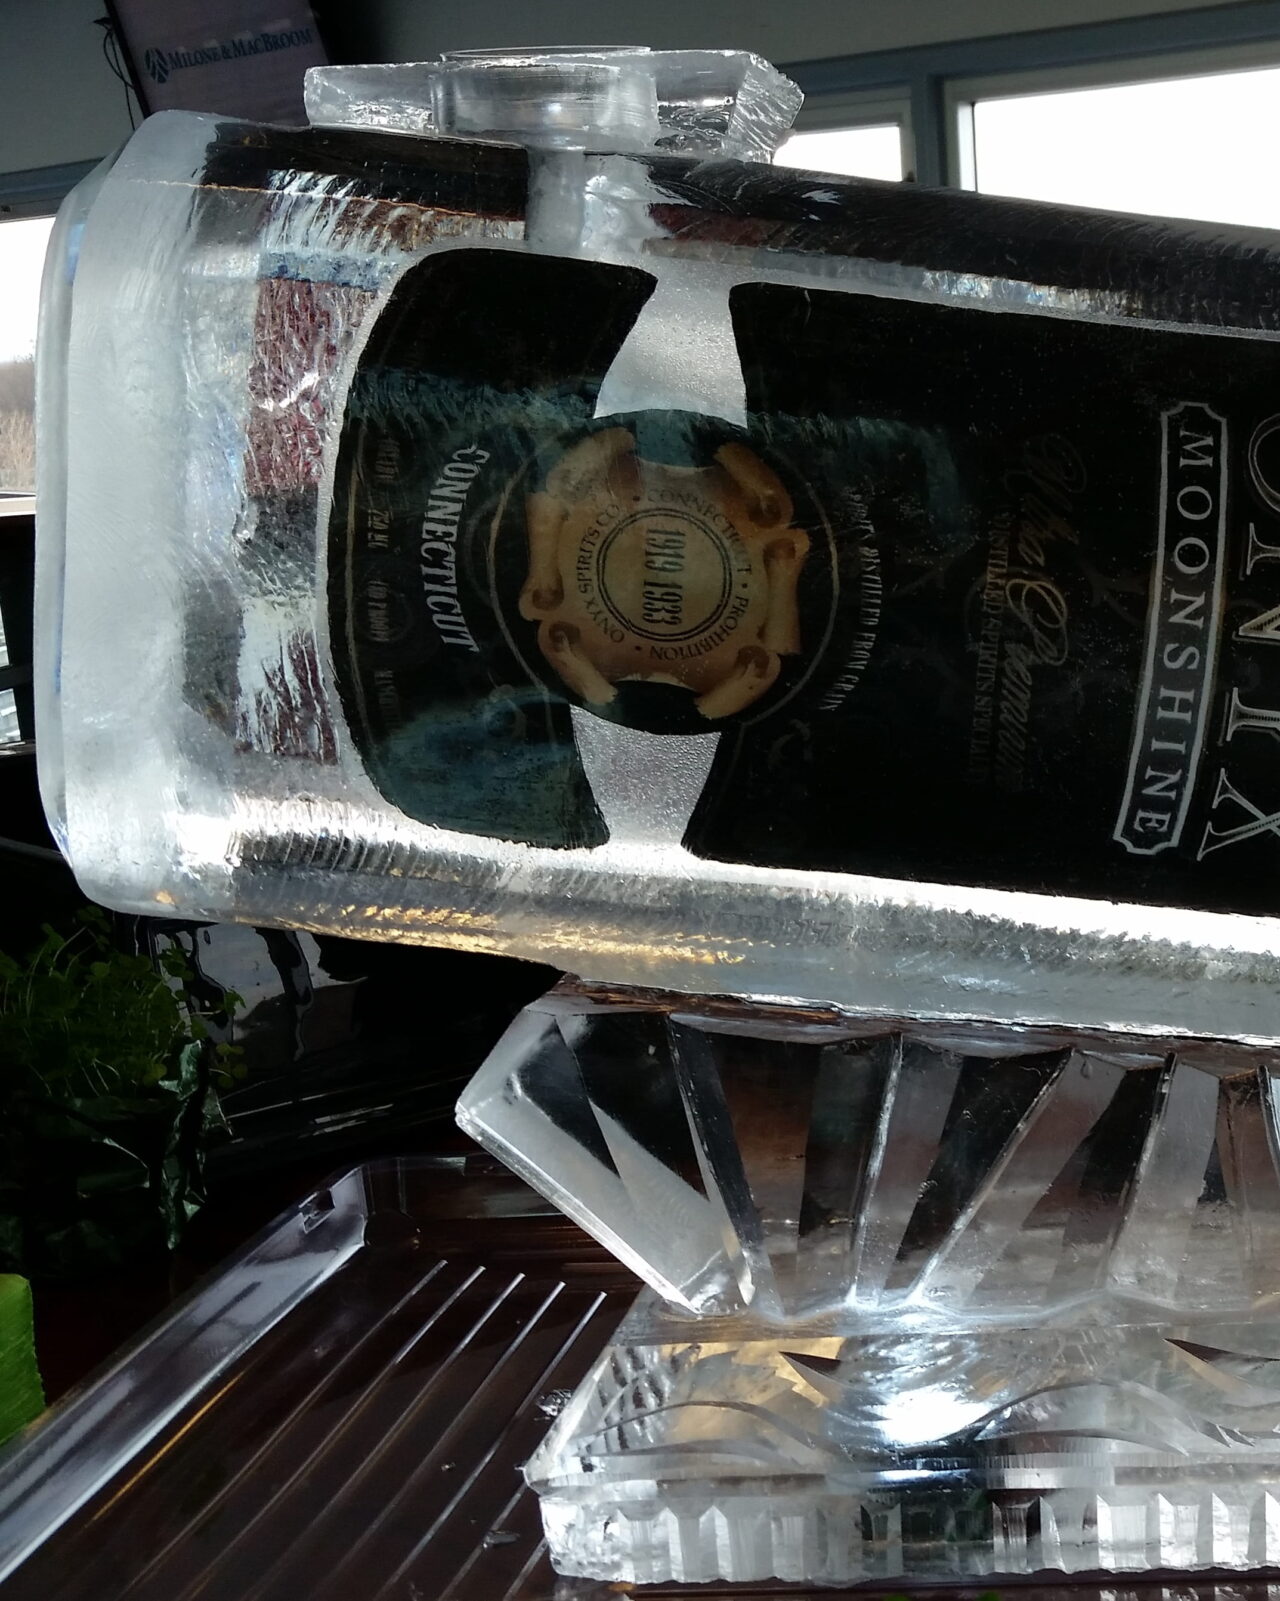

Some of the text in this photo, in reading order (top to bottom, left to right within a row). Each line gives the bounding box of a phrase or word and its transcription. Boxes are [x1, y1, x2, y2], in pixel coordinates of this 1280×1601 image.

[417, 444, 491, 655] CONNECTICUT
[575, 526, 600, 594] SPIRITS
[640, 528, 686, 626] 1919 1933
[583, 597, 625, 644] ONYX
[857, 545, 883, 627] DISTILLED
[647, 594, 749, 662] PROHIBITION
[843, 631, 876, 672] FROM
[973, 617, 1001, 691] SPIRITS
[1133, 429, 1214, 836] MOONSHINE
[815, 673, 861, 713] GRAIN
